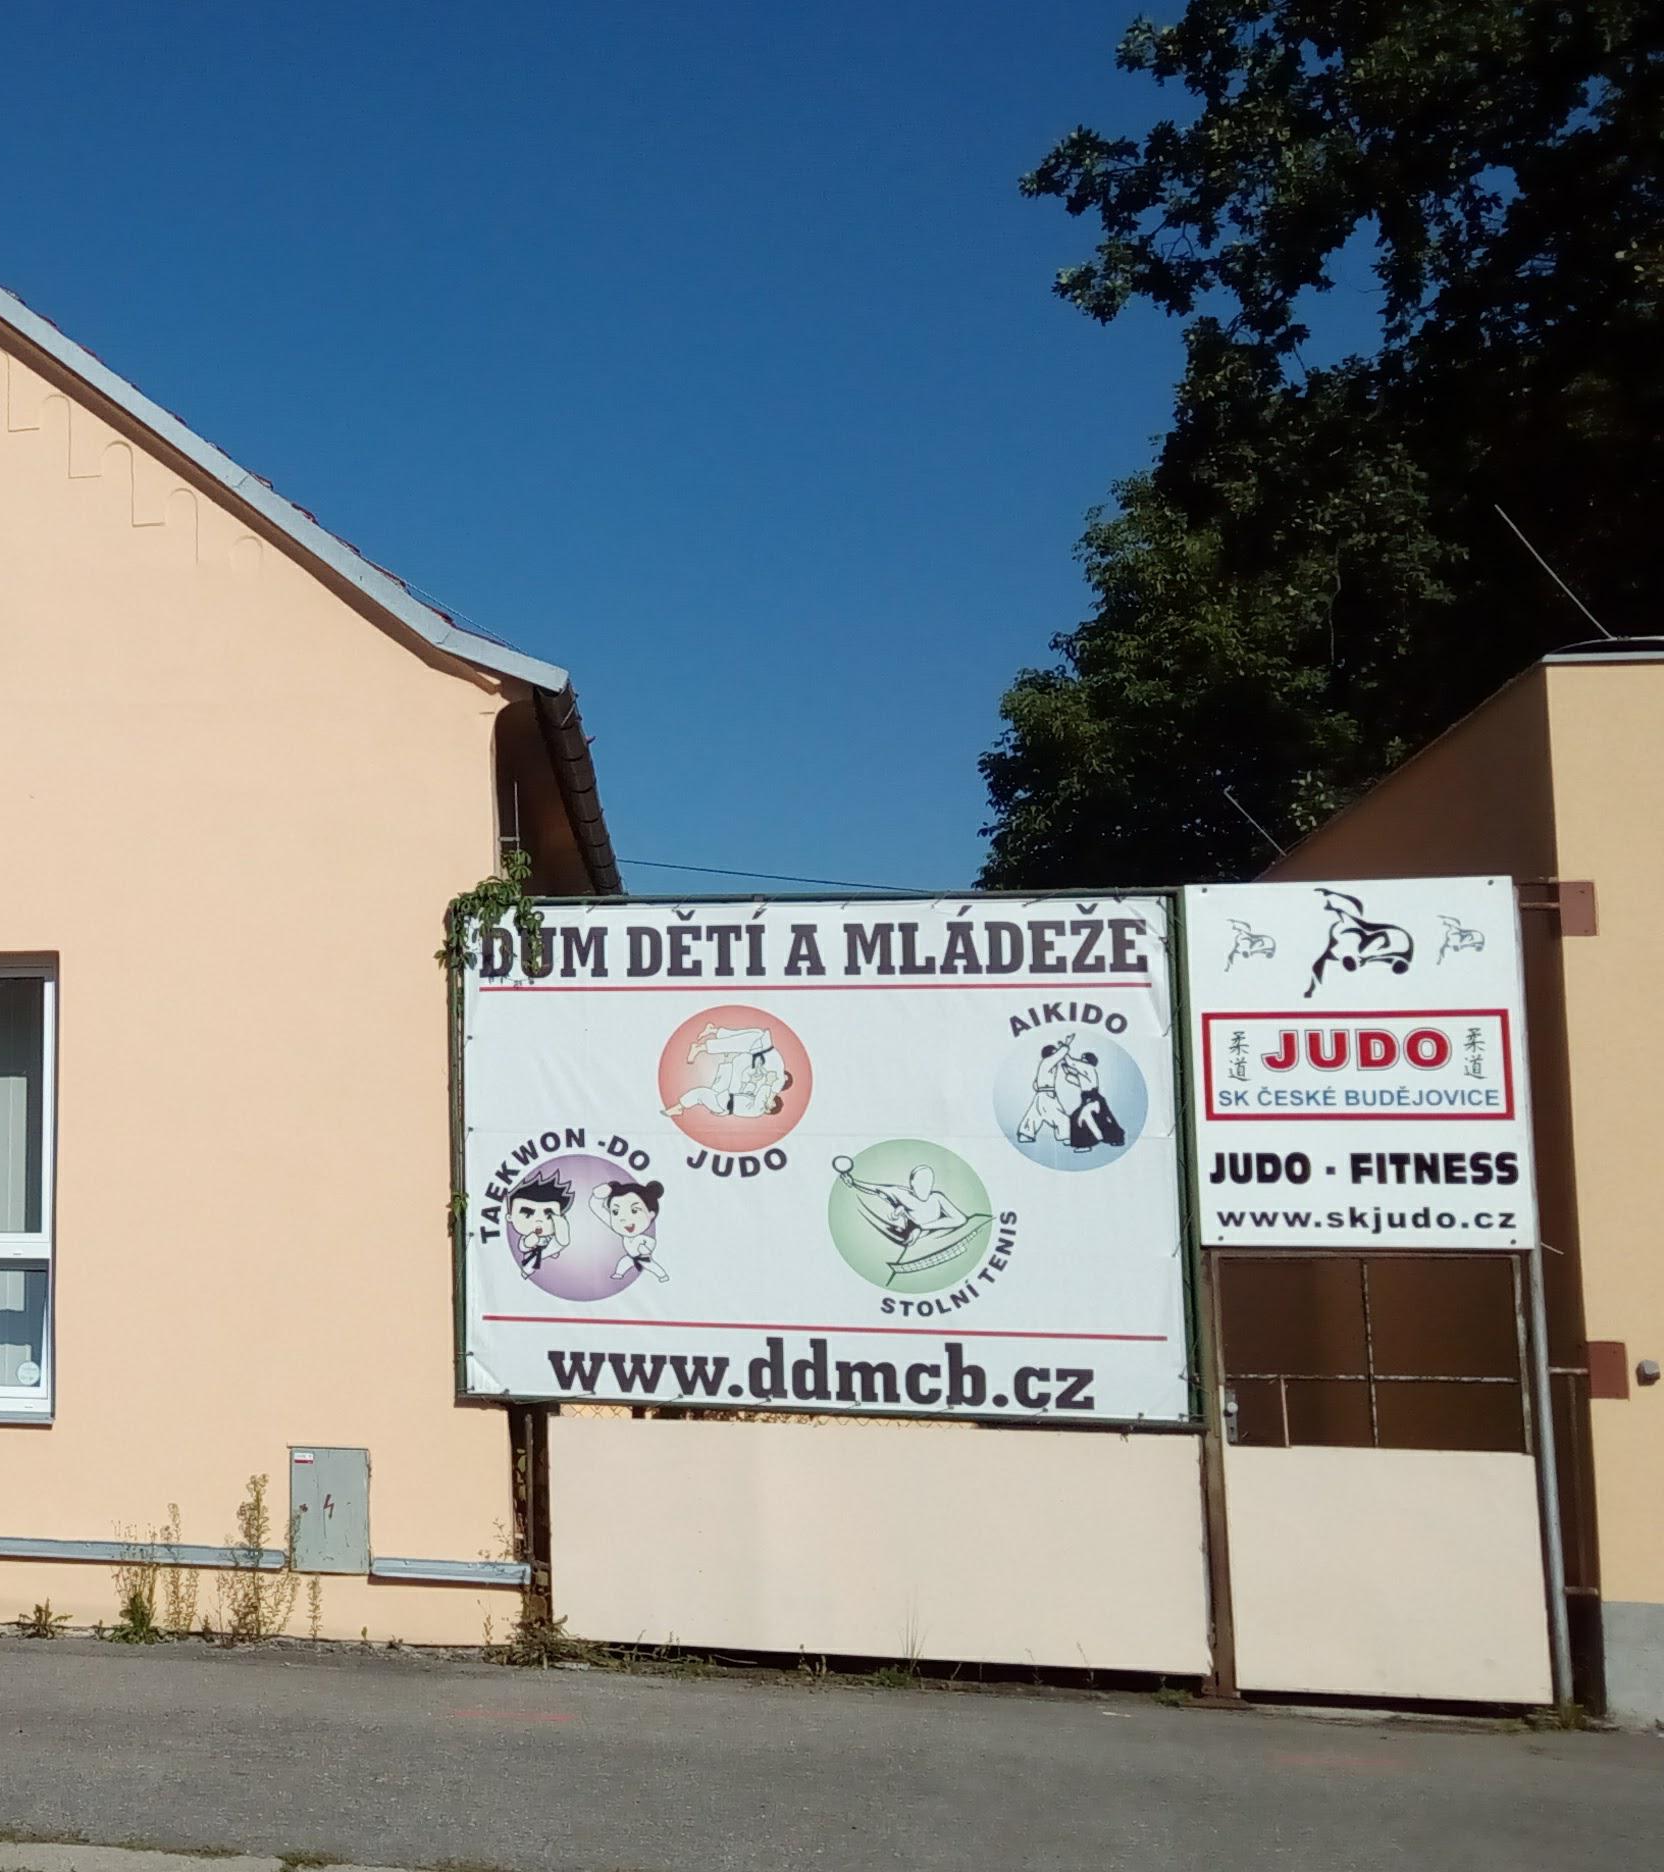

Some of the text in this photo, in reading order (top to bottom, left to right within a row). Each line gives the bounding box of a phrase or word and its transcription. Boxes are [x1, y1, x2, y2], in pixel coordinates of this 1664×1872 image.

[627, 907, 767, 977] DĚTÍ
[784, 924, 826, 976] A
[843, 903, 1148, 976] MLÁDEŽE
[1009, 1002, 1128, 1037] AIKIDO
[1261, 1027, 1452, 1072] JUDO
[1218, 1085, 1500, 1107] SK ČESKÉ BUDĚJOVICE
[687, 1148, 787, 1178] JUDO
[1209, 1151, 1312, 1185] JUDO
[1350, 1151, 1519, 1185] FITNESS
[480, 1128, 585, 1244] TAEKWON
[1216, 1206, 1517, 1235] www.skjudo.cz
[880, 1210, 1018, 1317] STOLNÍ TENIS
[547, 1337, 1095, 1410] www.ddmcb.cz
